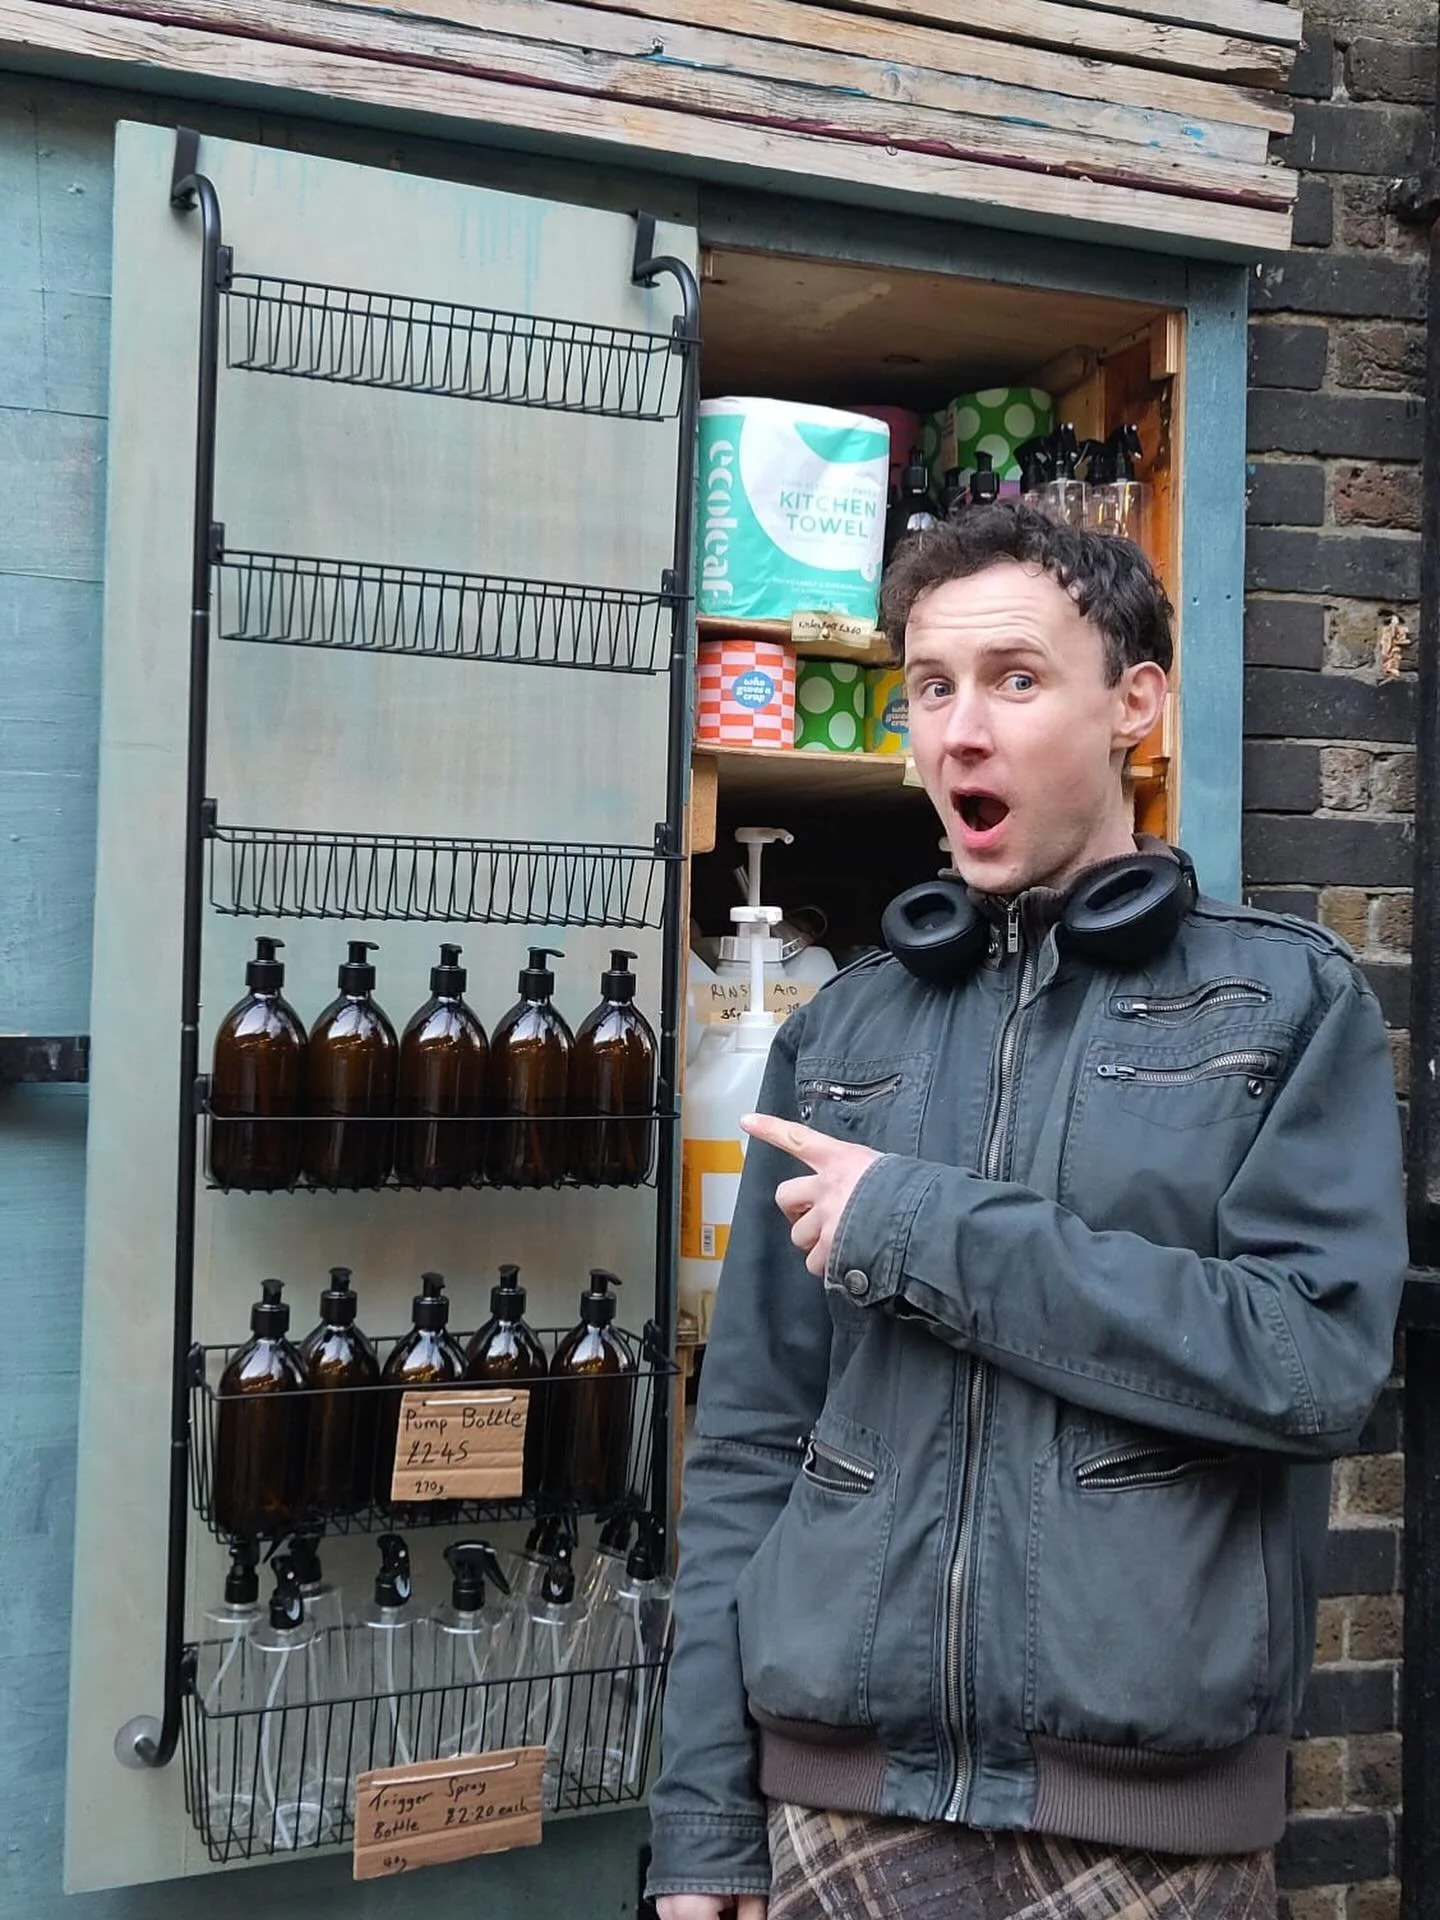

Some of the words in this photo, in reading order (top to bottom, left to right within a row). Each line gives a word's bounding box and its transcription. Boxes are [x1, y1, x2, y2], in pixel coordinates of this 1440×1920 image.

[779, 490, 877, 518] KITCHEN
[702, 439, 739, 598] ecoleaf
[786, 513, 869, 538] TOWEL
[743, 694, 766, 704] crap
[710, 983, 749, 1001] RINS
[773, 984, 798, 996] AID
[405, 1409, 448, 1436] Pump
[462, 1408, 523, 1429] Bottle
[368, 1785, 434, 1815] Trigger
[446, 1777, 487, 1802] Spray
[373, 1818, 420, 1840] Bottle
[498, 1798, 531, 1816] each
